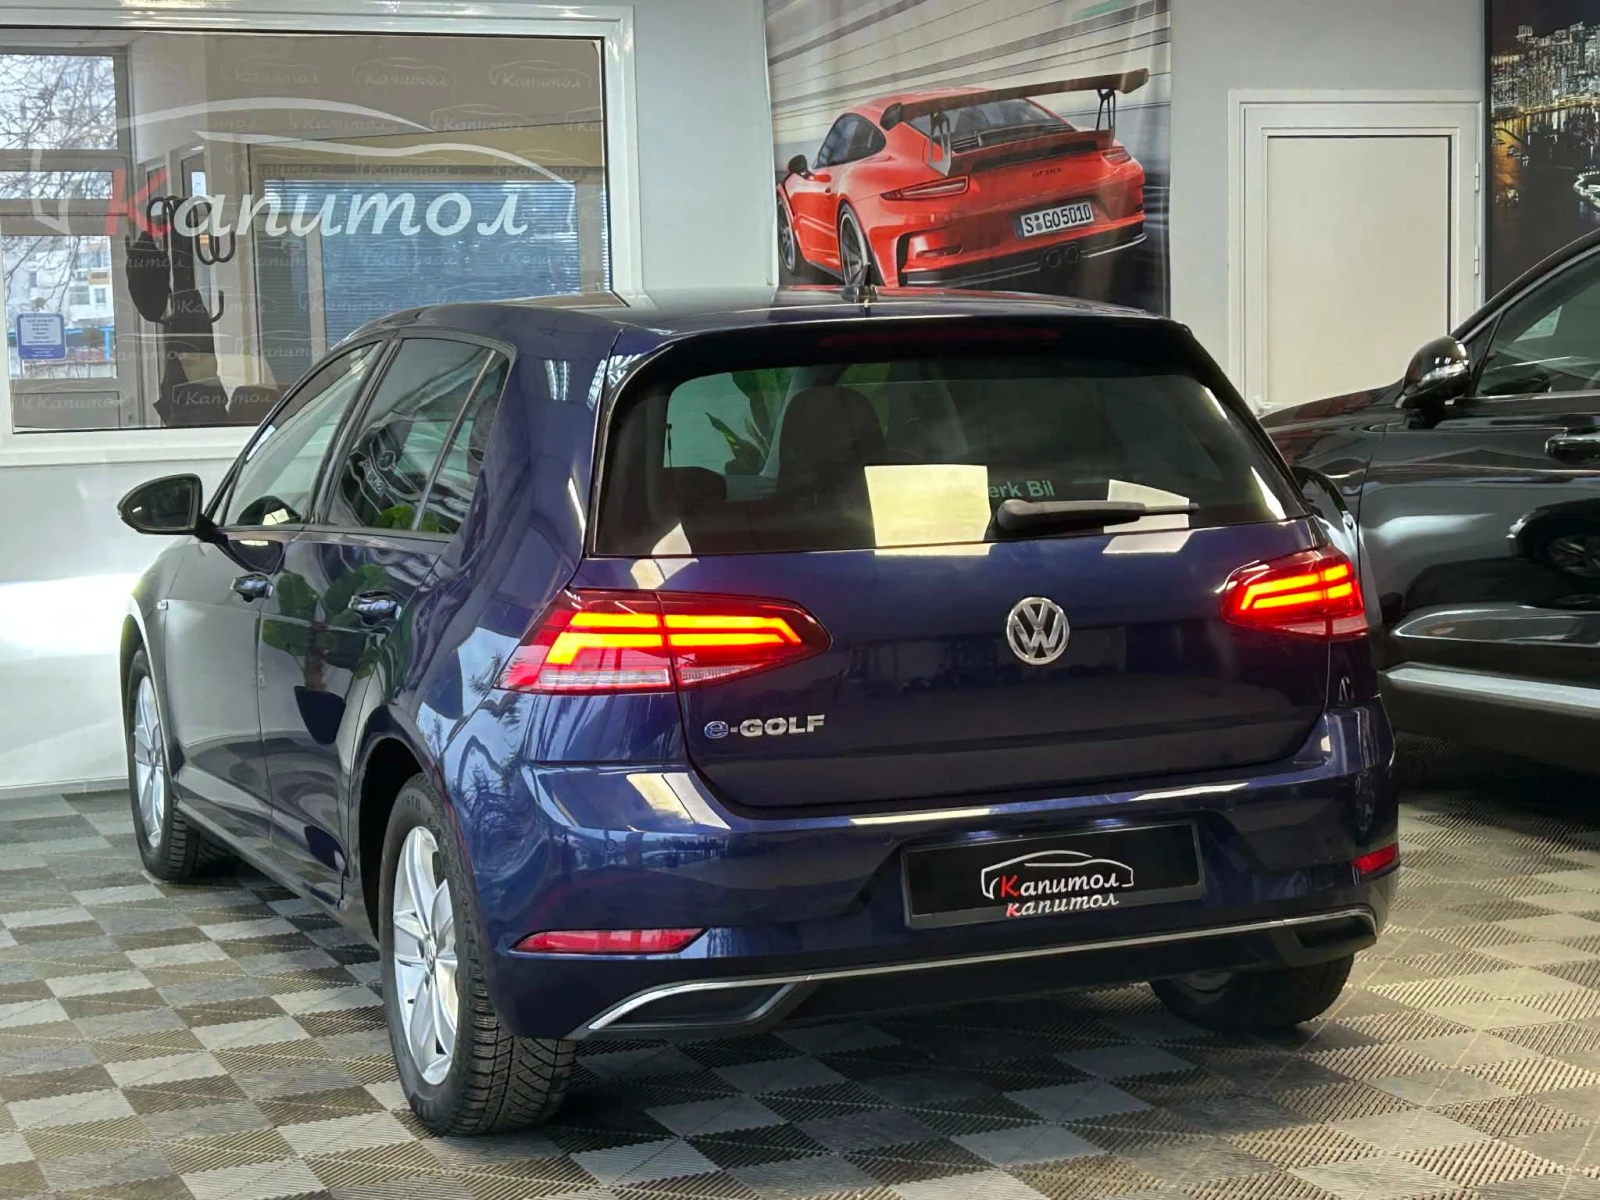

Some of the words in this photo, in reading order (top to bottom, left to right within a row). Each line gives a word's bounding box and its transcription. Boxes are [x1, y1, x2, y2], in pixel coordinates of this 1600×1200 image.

[105, 167, 528, 237] Капитол
[1026, 480, 1055, 496] Bil
[704, 714, 825, 739] e-GOLF
[1000, 873, 1120, 898] Капитол
